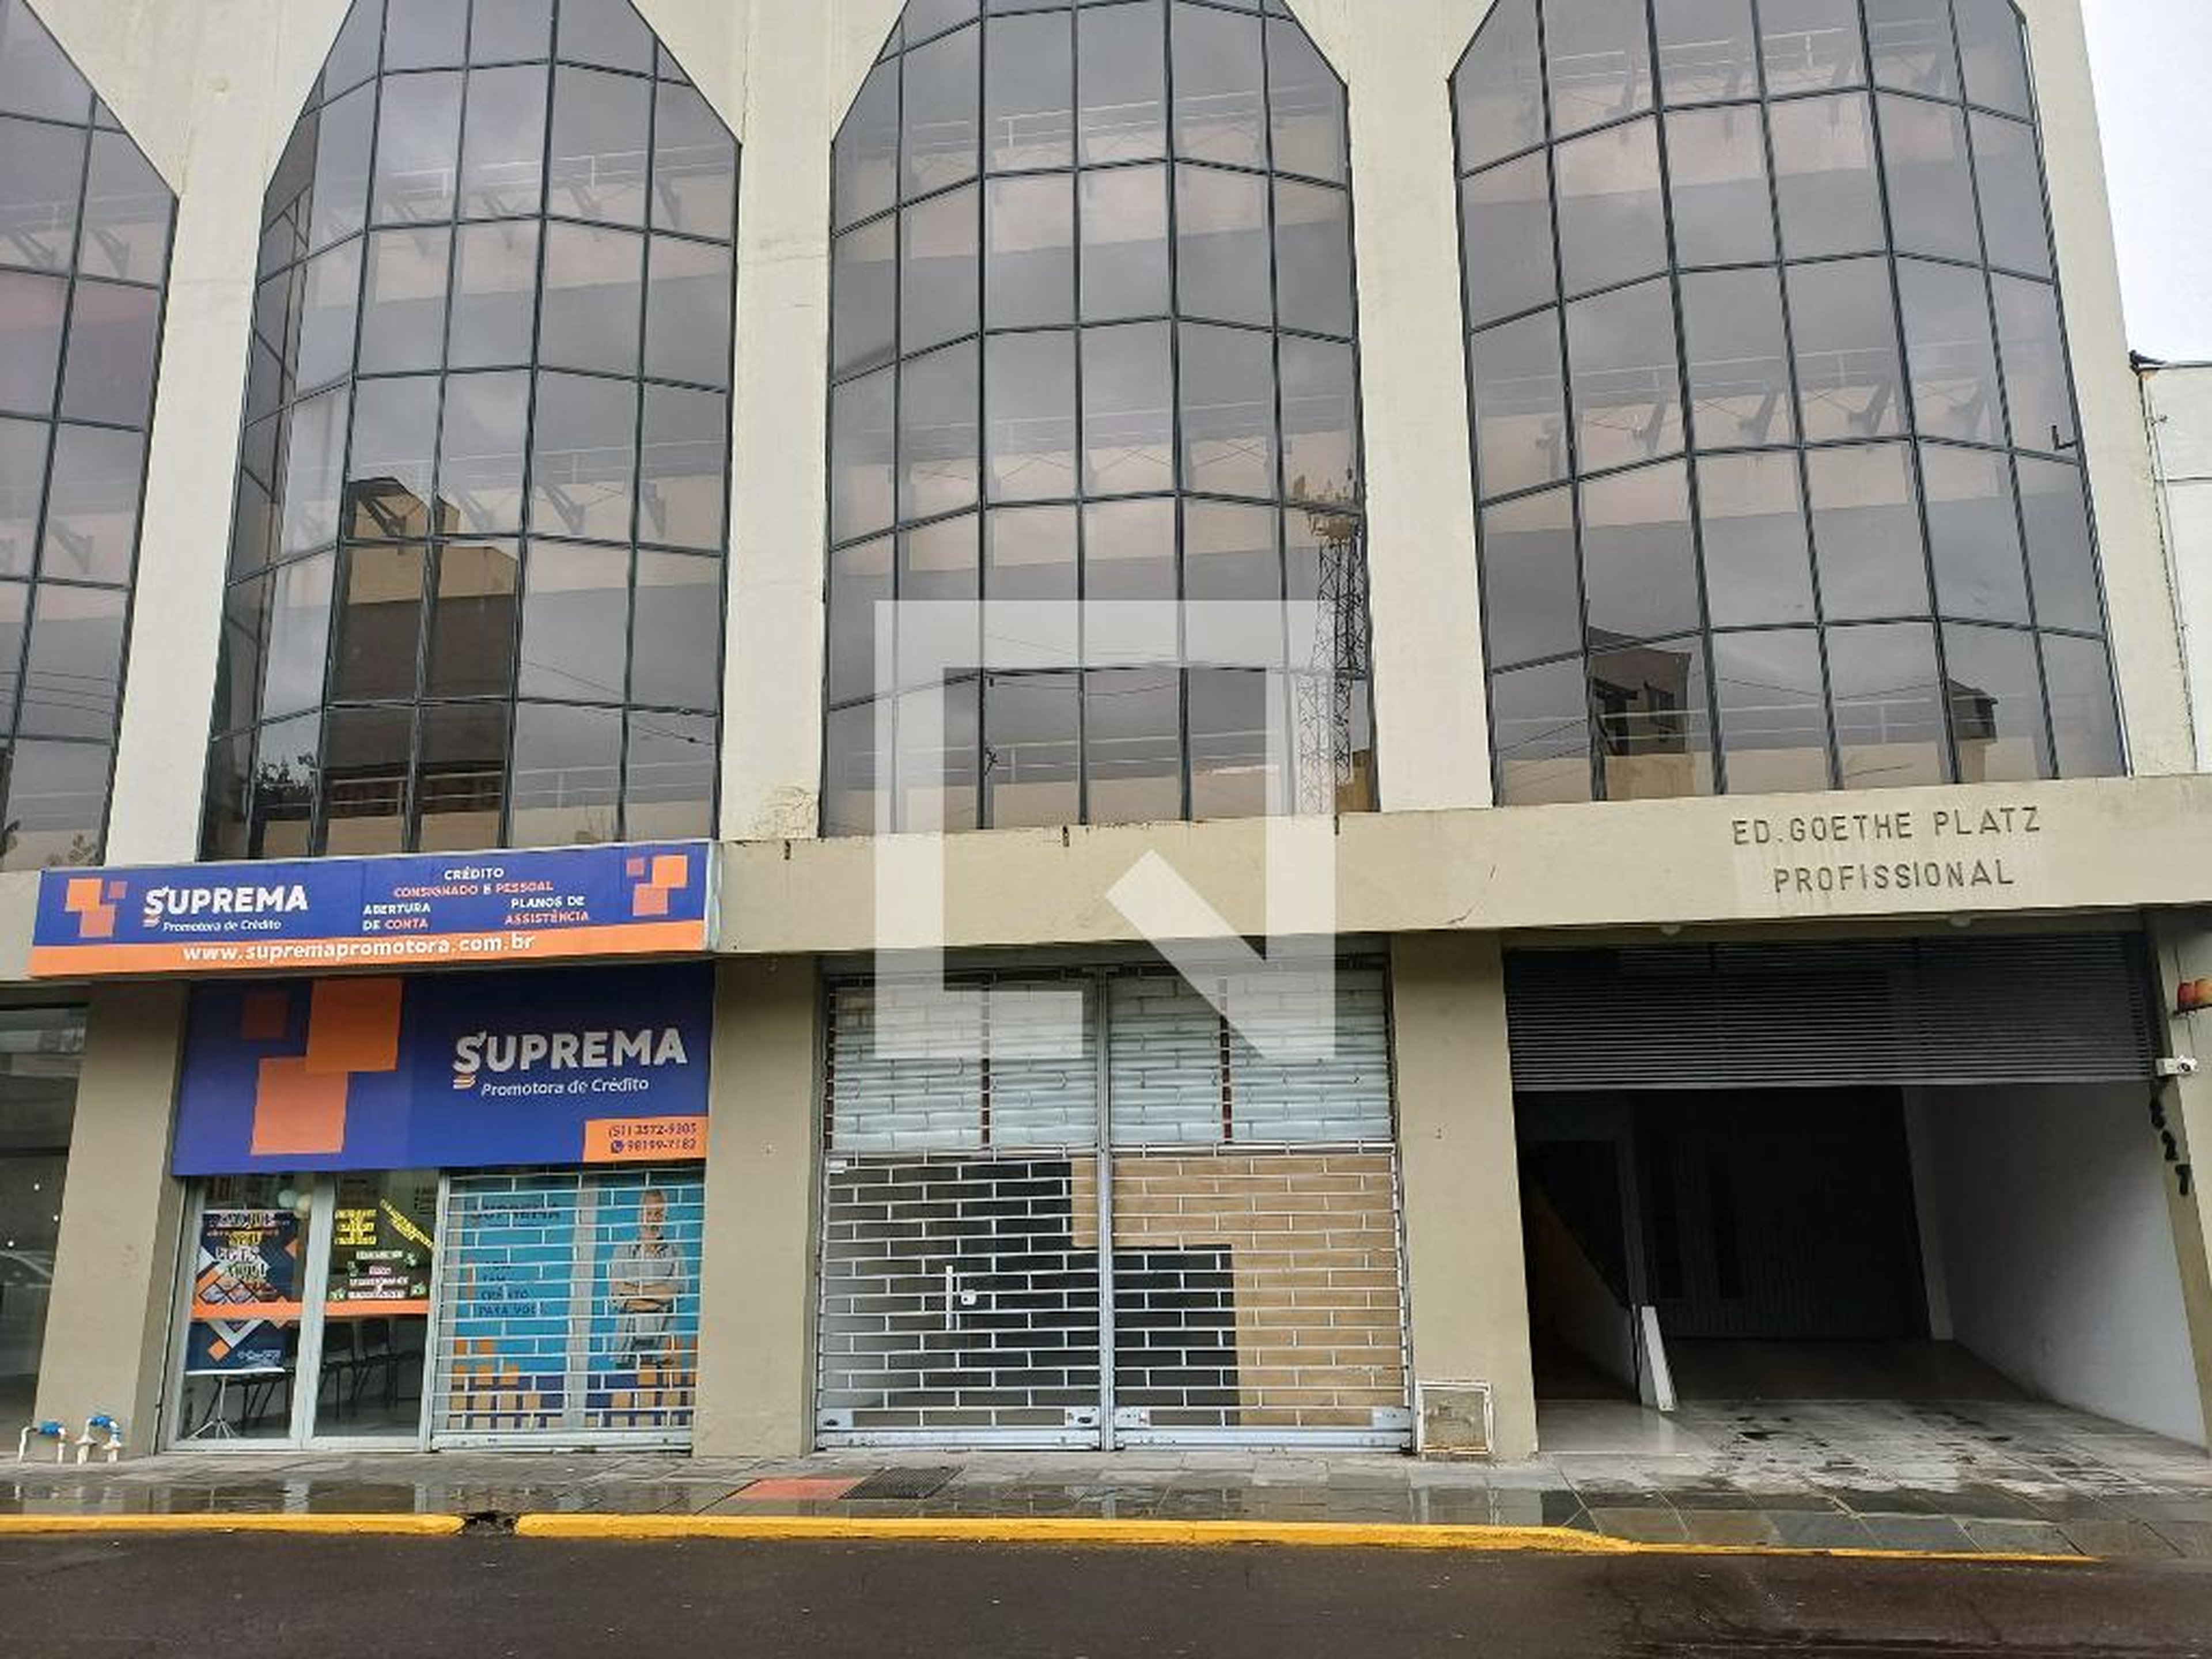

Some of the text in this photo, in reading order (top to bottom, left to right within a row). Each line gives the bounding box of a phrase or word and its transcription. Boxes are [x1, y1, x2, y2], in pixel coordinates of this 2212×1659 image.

[1933, 806, 2041, 836] PLATZ
[445, 866, 505, 881] CRÉDITO
[1773, 858, 2015, 893] PROFISSIONAL
[393, 884, 479, 899] CONSIGNADO
[495, 880, 554, 895] PESSOAL
[143, 885, 308, 916] SUPREMA
[362, 902, 431, 916] ABERTURA
[511, 895, 585, 909] PLANOS DE
[162, 918, 282, 932] Promotora de Crédito
[362, 918, 429, 931] DE CONTA
[504, 911, 589, 926] ASSISTÊNCIA
[182, 933, 537, 964] www.supremapromotora.com.br
[452, 1028, 688, 1073] SUPREMA
[481, 1077, 649, 1097] Promotora de Crédito
